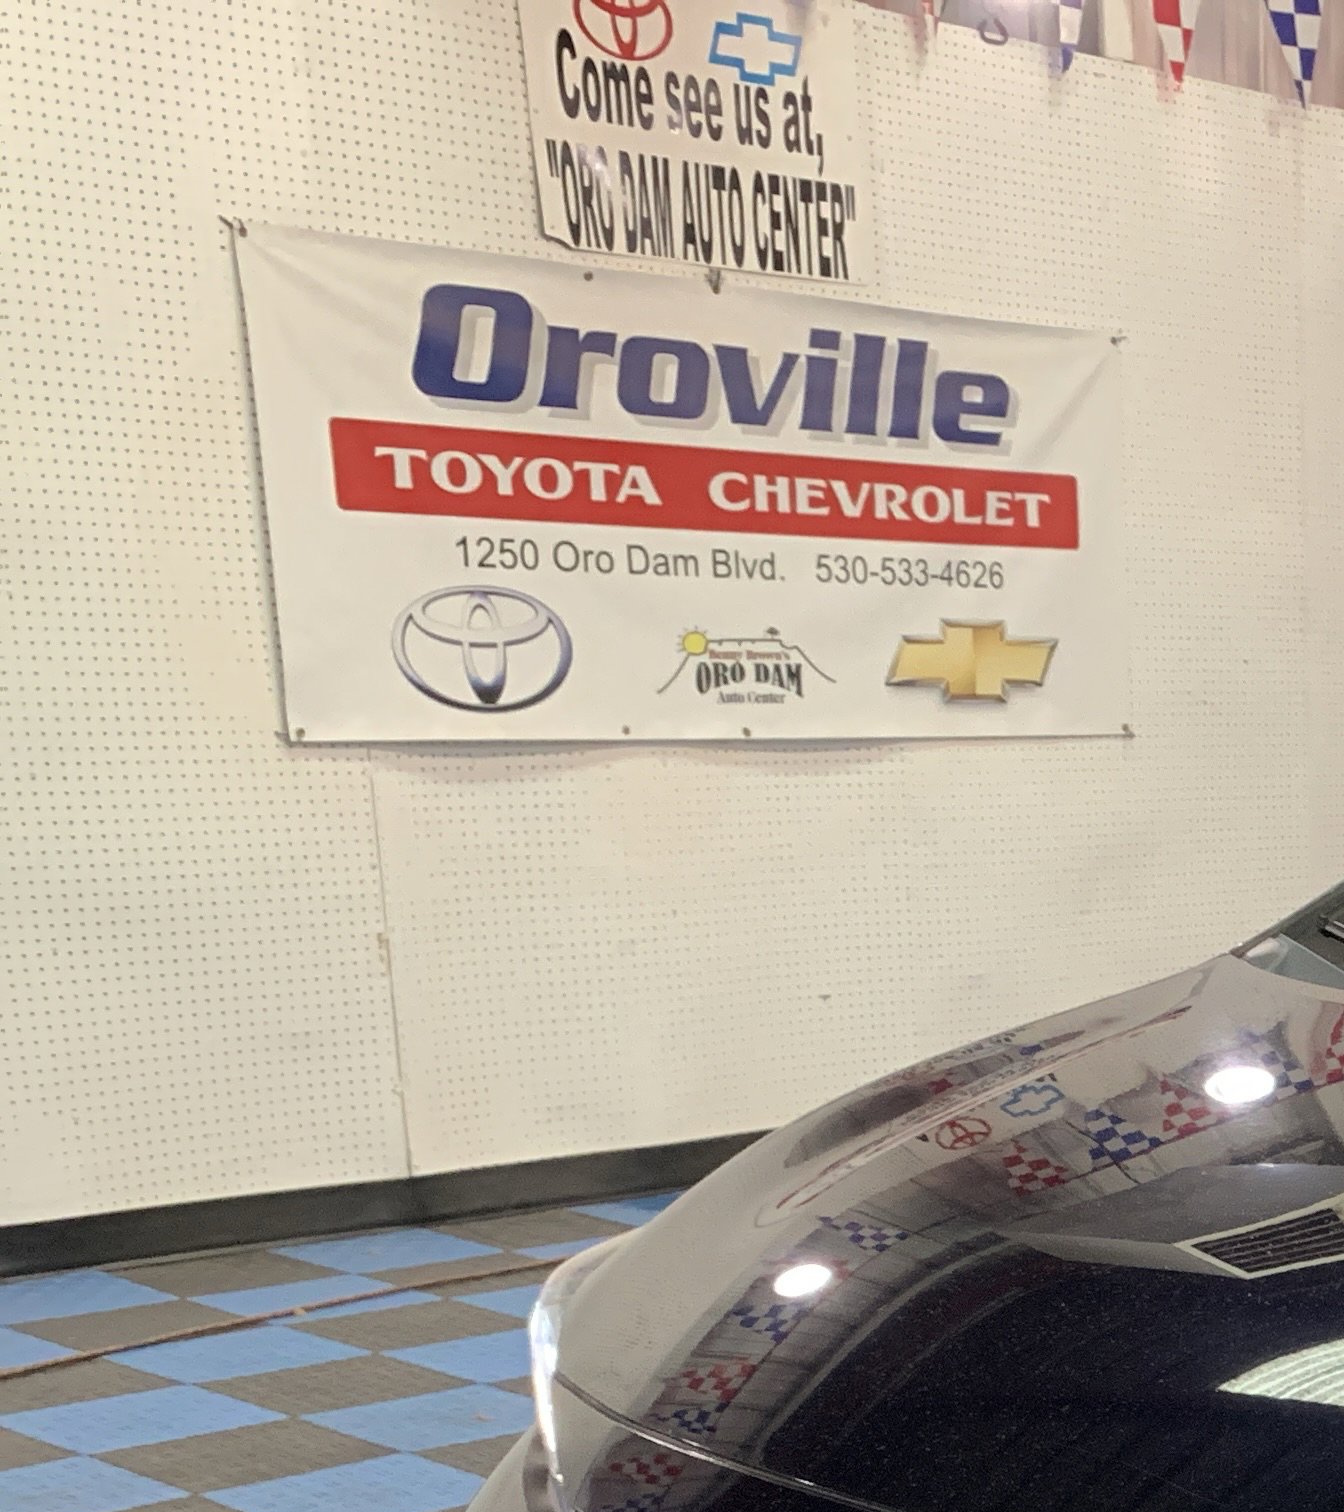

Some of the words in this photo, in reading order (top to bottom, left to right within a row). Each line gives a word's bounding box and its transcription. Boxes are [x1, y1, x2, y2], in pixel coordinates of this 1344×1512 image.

[556, 28, 654, 131] Come
[665, 71, 723, 142] see
[734, 83, 771, 149] us
[783, 75, 824, 177] at,
[618, 150, 675, 258] DAM
[682, 160, 745, 268] AUTO
[752, 170, 856, 280] CENTER"
[411, 283, 1011, 447] Oroville
[375, 446, 663, 507] TOYOTA
[708, 471, 1050, 528] CHEVROLET
[456, 536, 539, 570] 1250
[553, 541, 615, 574] Oro
[626, 544, 699, 577] Dam
[712, 548, 786, 581] Blvd.
[815, 553, 1005, 590] 530-533-4626
[695, 662, 745, 694] ORO
[754, 663, 804, 698] DAM
[717, 691, 746, 704] Auto
[747, 691, 786, 704] Center
